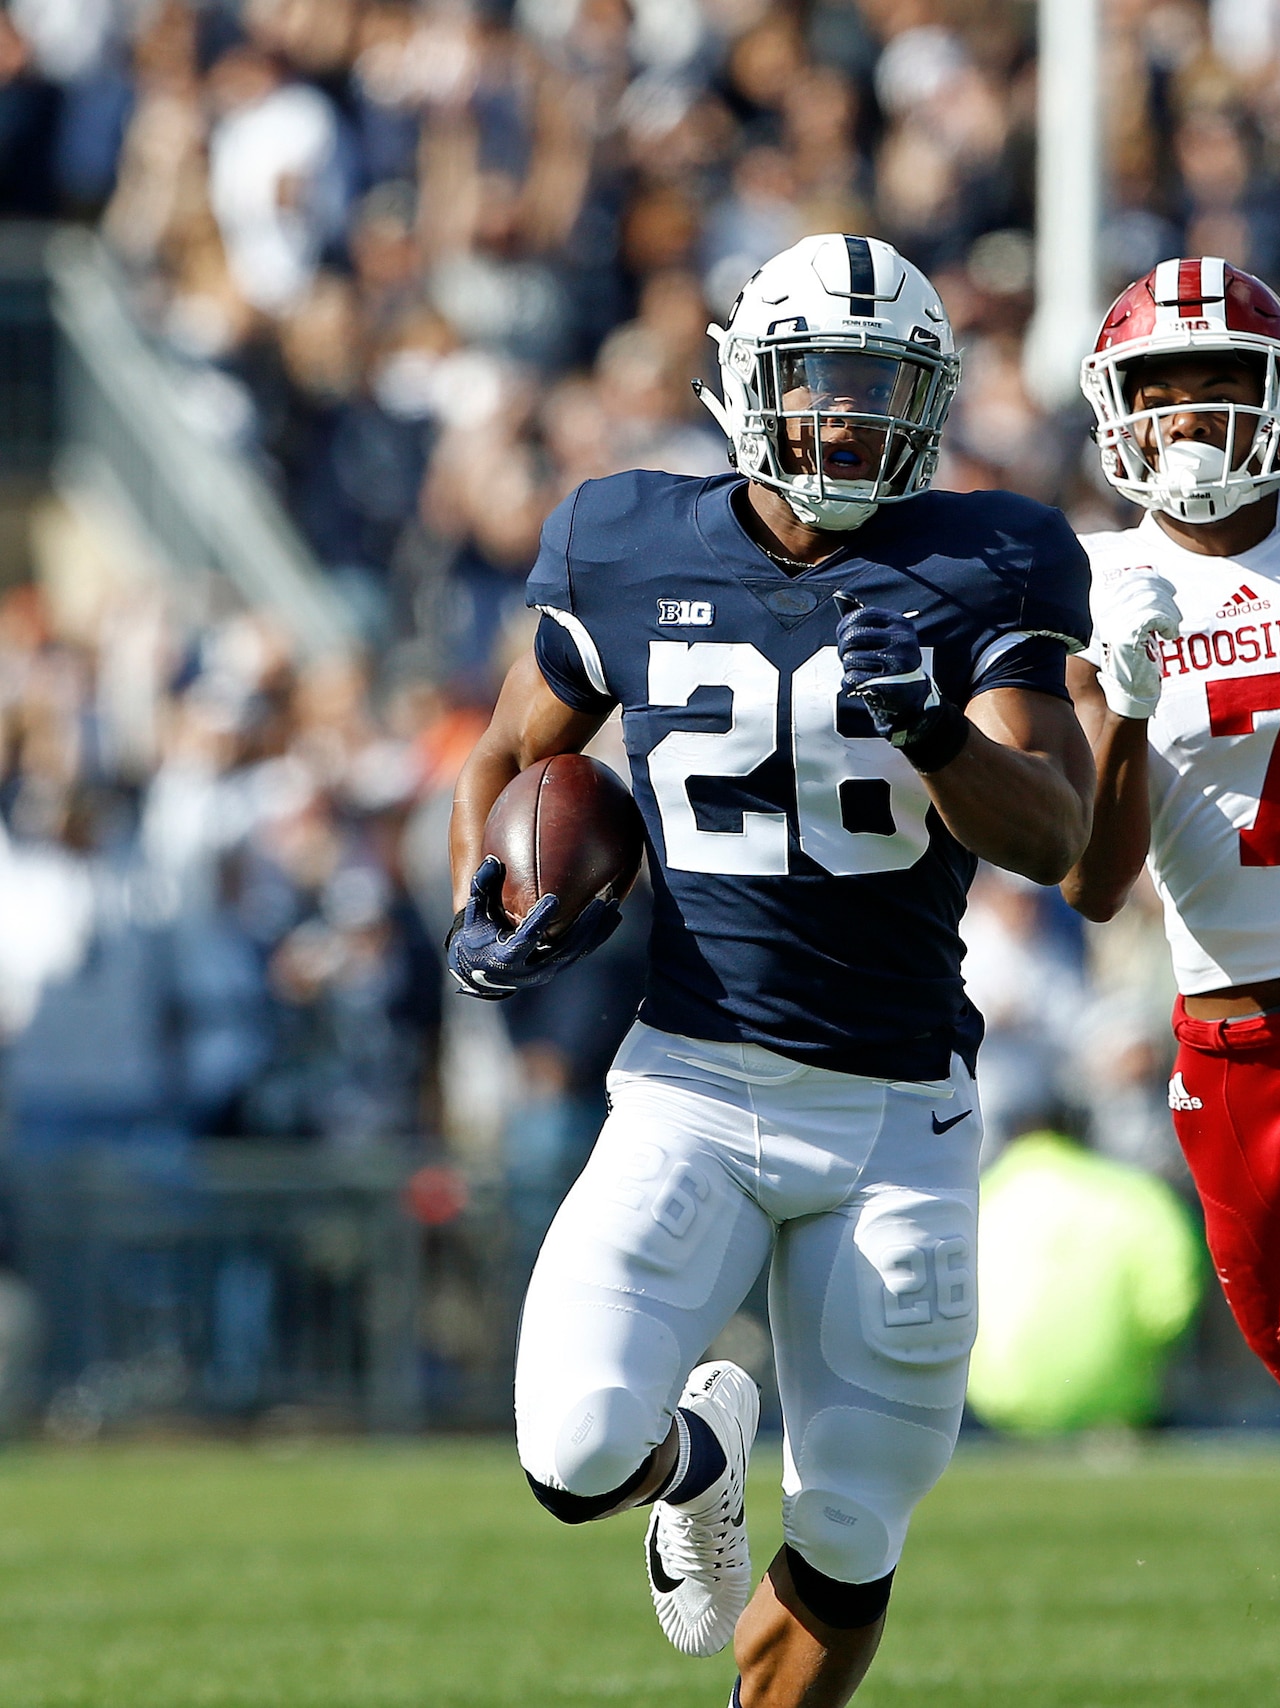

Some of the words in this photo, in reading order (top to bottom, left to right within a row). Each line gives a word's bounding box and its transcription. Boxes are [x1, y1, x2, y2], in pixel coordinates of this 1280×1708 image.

[842, 319, 861, 327] PENN
[862, 320, 883, 329] STATE
[1215, 600, 1271, 619] adidas
[647, 641, 934, 876] 26
[882, 1235, 973, 1328] 26
